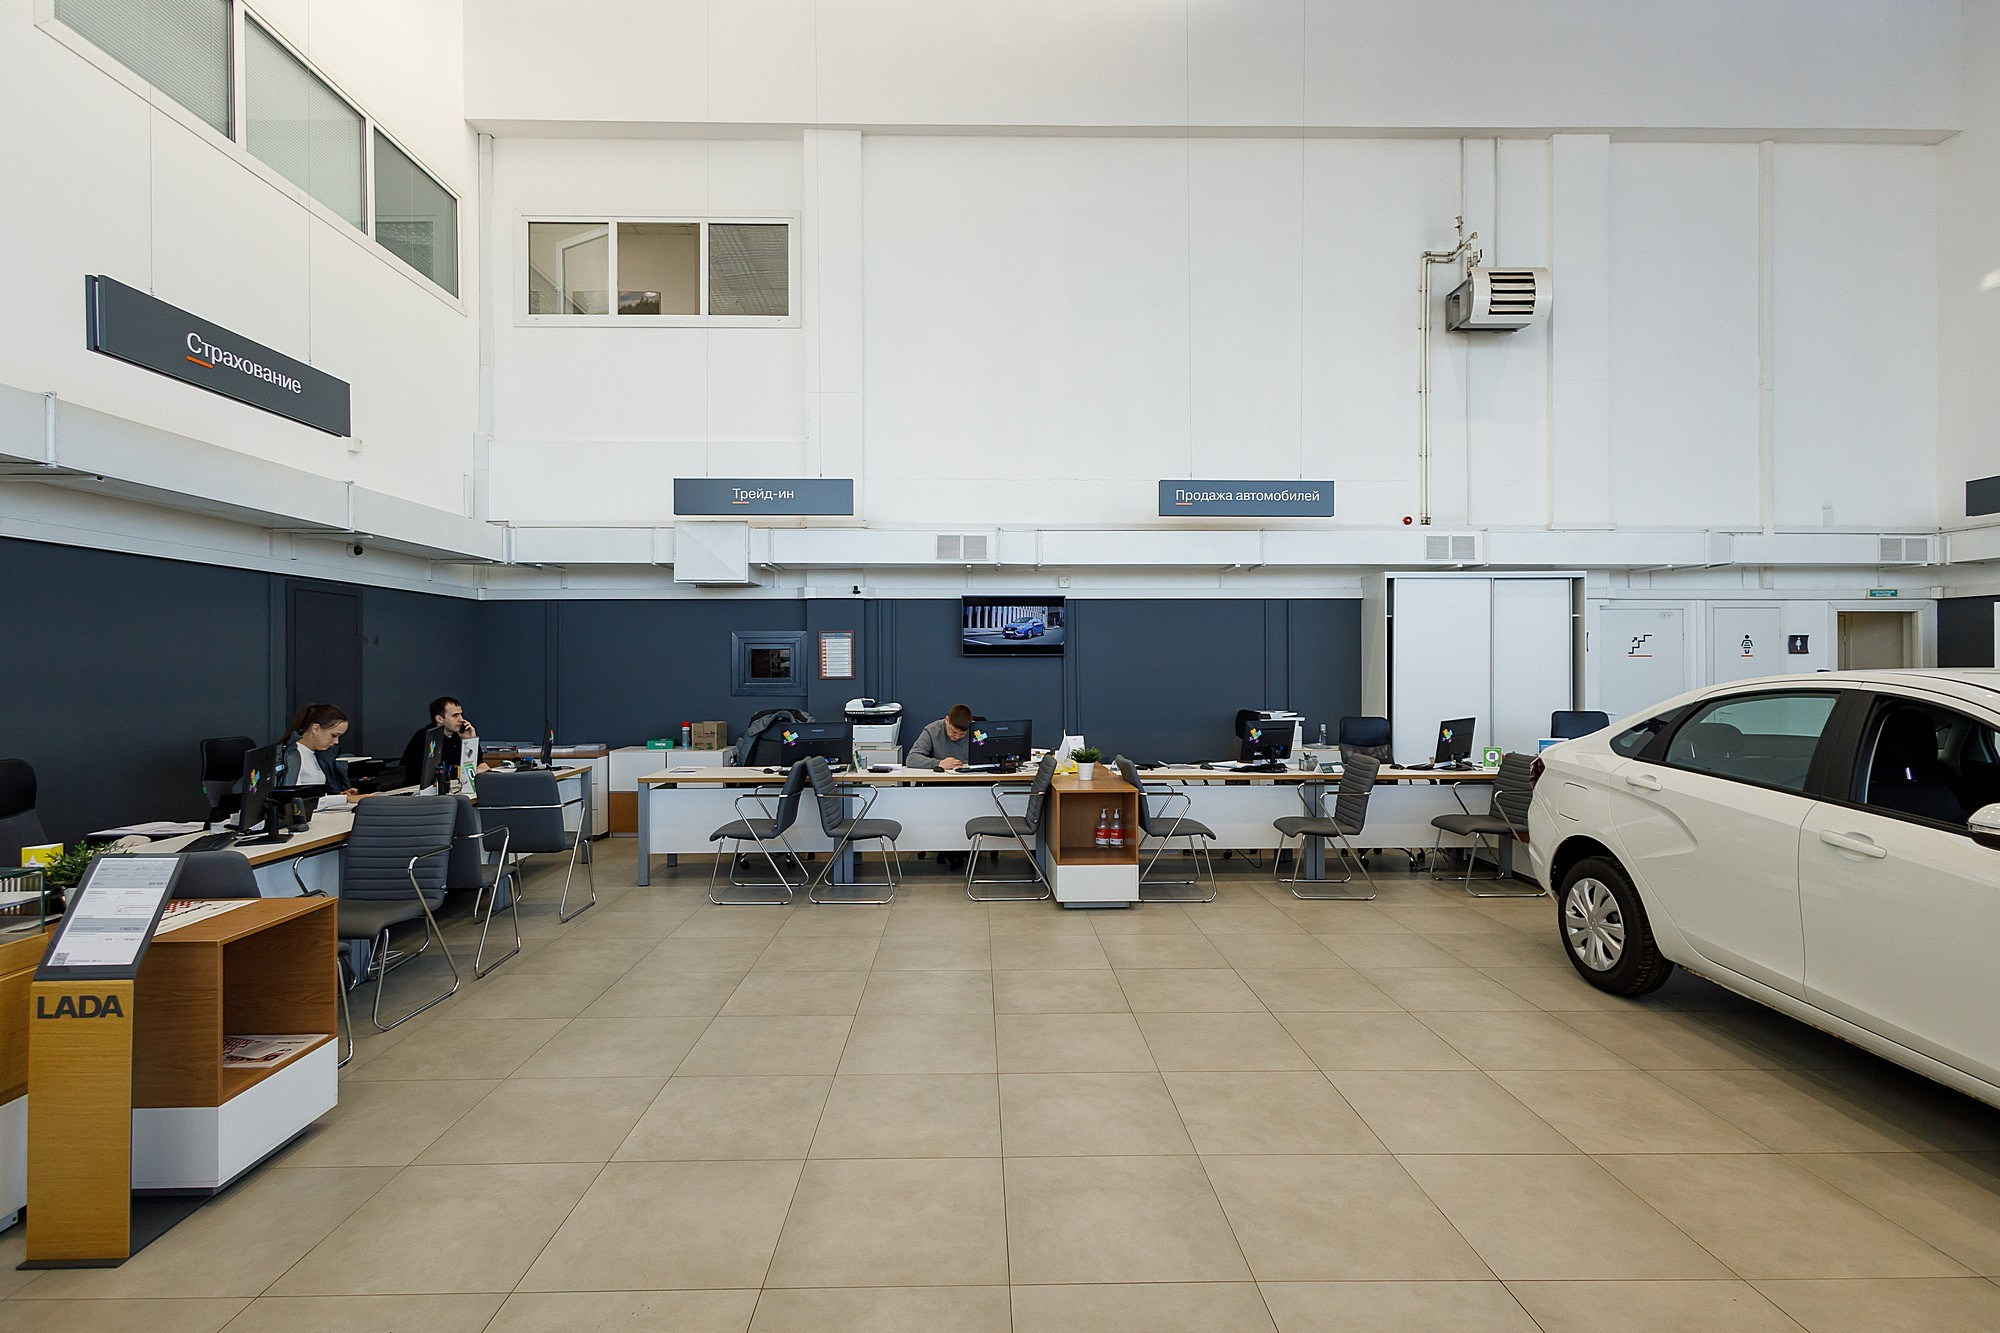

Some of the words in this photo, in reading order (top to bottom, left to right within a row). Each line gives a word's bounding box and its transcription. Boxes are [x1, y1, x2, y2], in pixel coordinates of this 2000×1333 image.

[186, 332, 302, 394] Страхование
[732, 488, 795, 501] Трейд-ин
[1175, 489, 1233, 503] Продажа
[1235, 490, 1320, 502] автомобилей
[37, 995, 124, 1019] LADA
